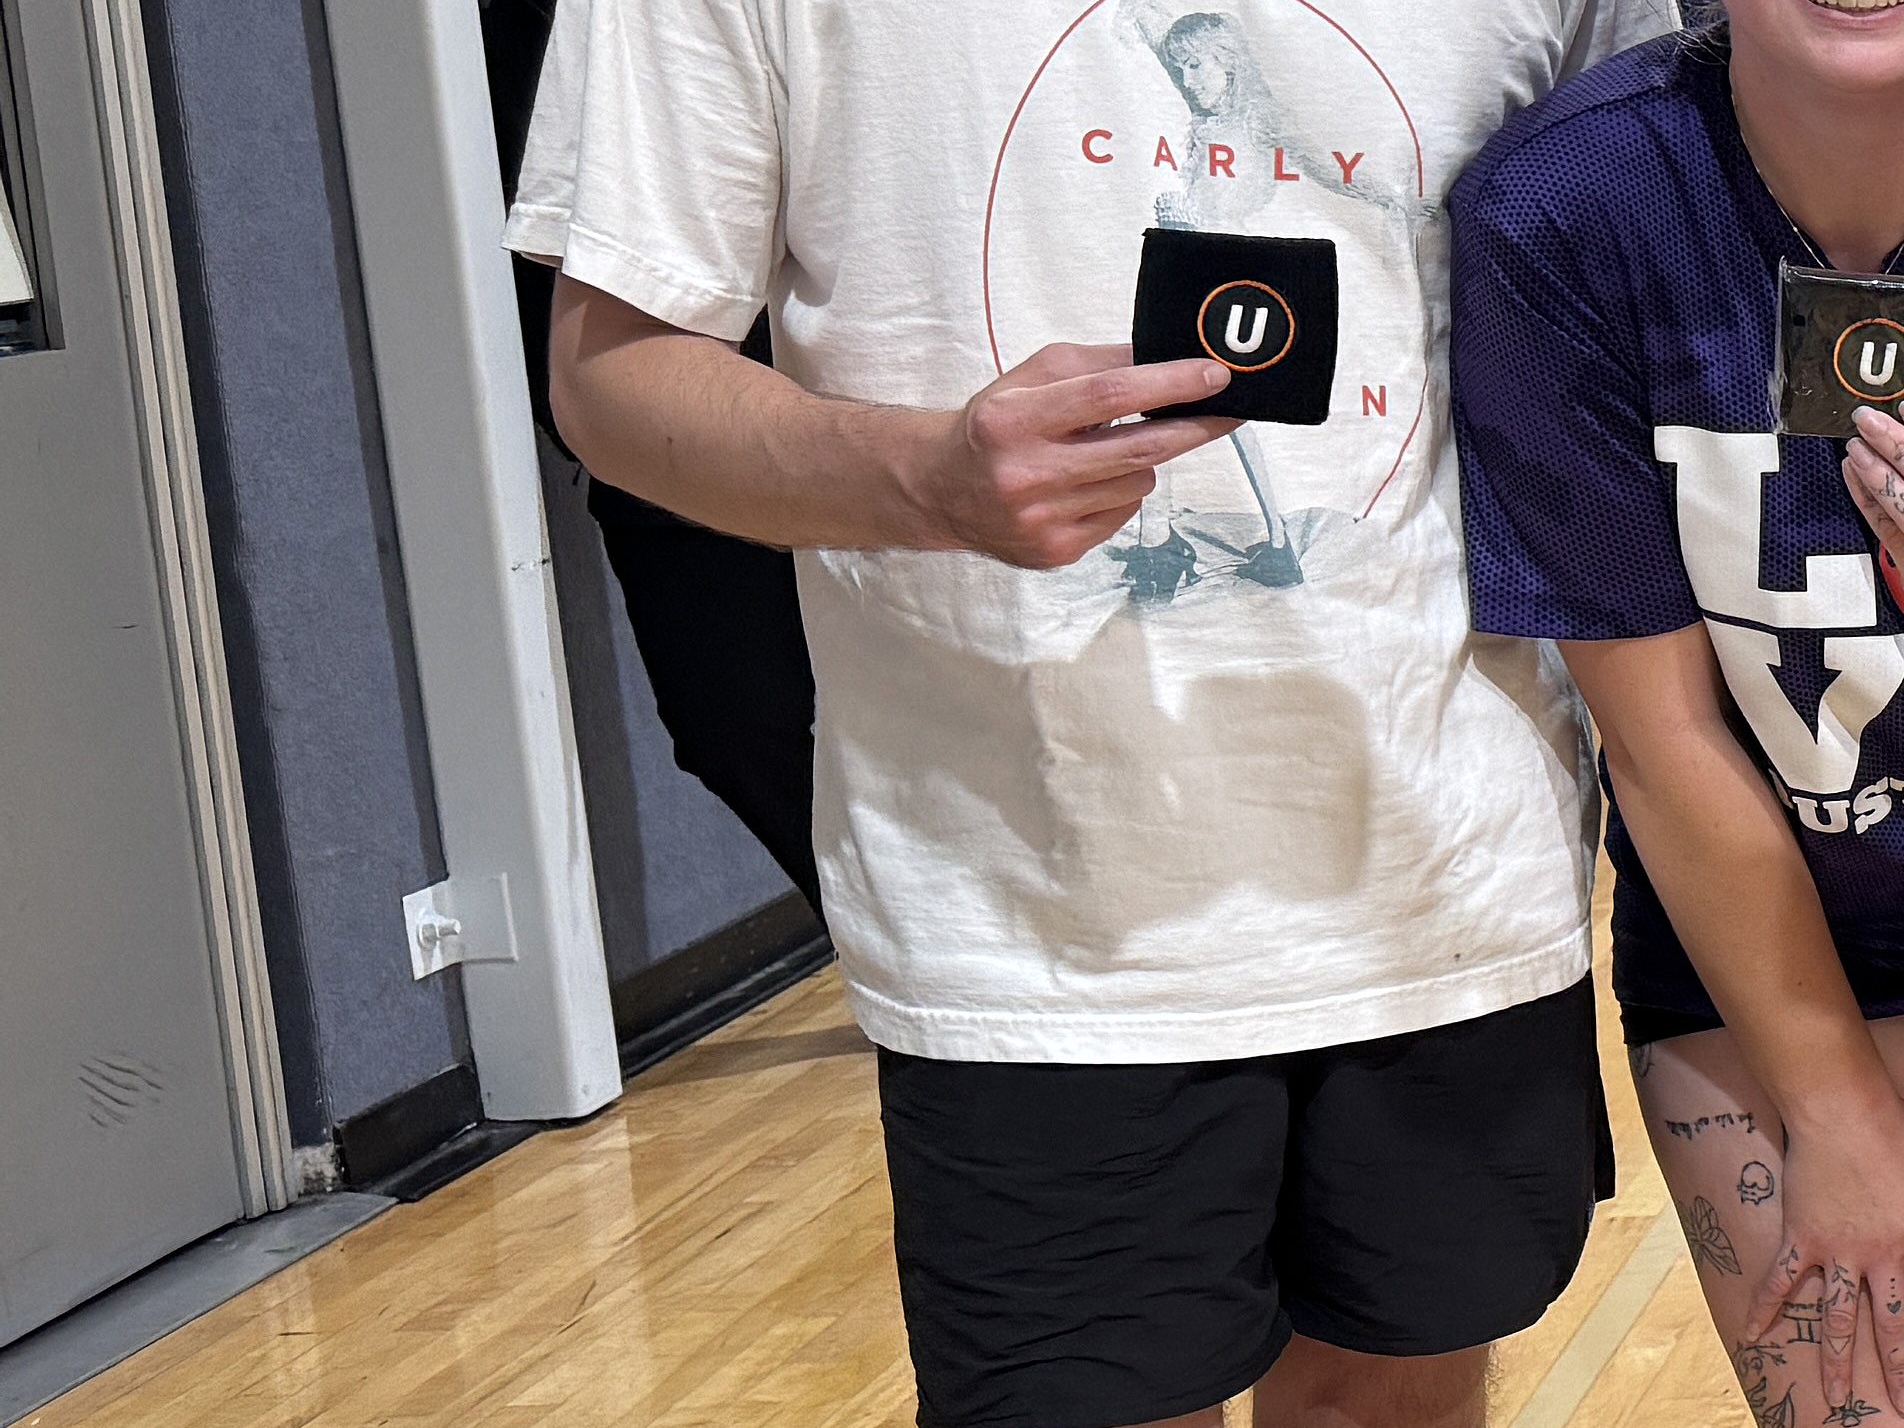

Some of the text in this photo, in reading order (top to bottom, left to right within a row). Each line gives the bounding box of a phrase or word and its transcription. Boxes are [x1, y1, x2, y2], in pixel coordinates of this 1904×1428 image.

[1080, 128, 1365, 185] CARLY
[1223, 304, 1268, 354] U
[1859, 340, 1898, 385] U
